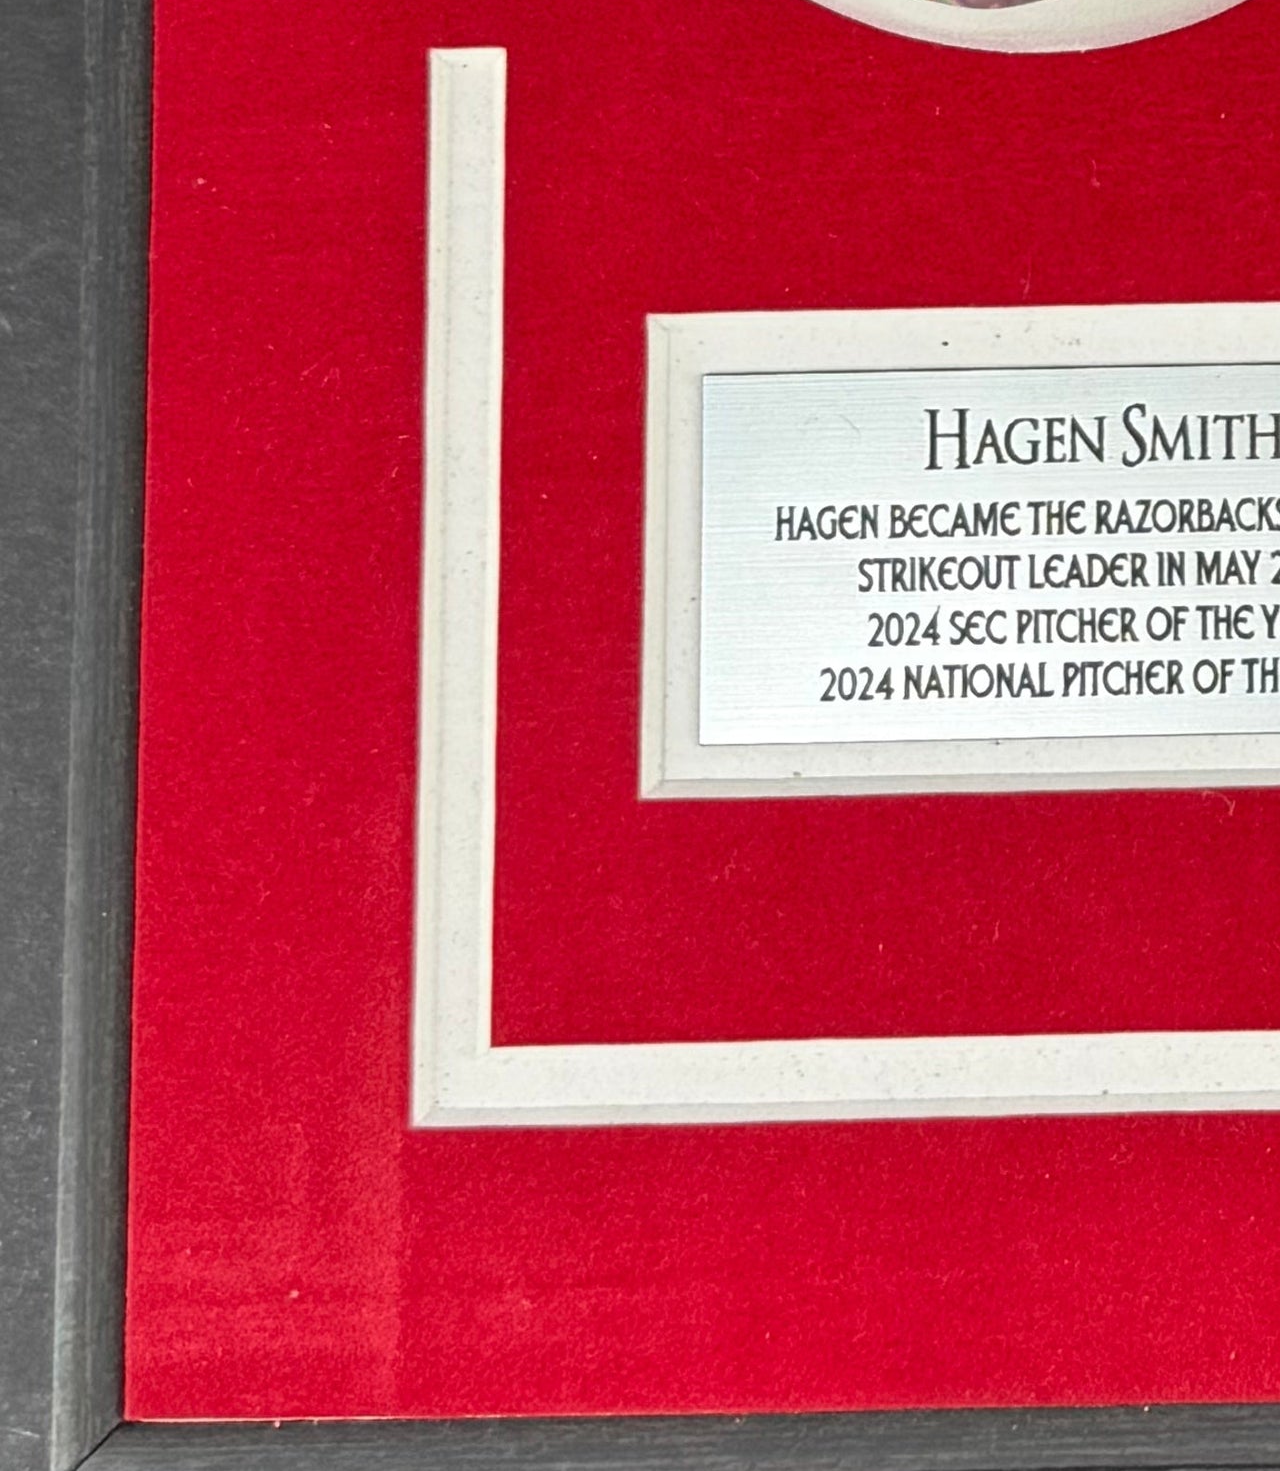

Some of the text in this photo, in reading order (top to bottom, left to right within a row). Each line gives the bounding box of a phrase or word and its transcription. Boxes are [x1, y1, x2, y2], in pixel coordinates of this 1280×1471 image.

[775, 504, 879, 542] HAGEN
[889, 501, 1021, 540] BECAME
[1027, 500, 1087, 536] THE
[857, 555, 1022, 592] STRIKEOUT
[1029, 553, 1150, 589] LEADER
[1157, 551, 1186, 587] IN
[1196, 550, 1262, 586] MAY
[867, 611, 941, 647] 2024
[949, 610, 1008, 646] SEC
[1016, 607, 1139, 644] PITCHER
[1146, 606, 1190, 641] OF
[1195, 604, 1256, 640] THE
[819, 666, 895, 702] 2024
[903, 662, 1055, 700] NATIONAL
[1062, 660, 1185, 697] PITCHER
[1192, 658, 1236, 695] OF
